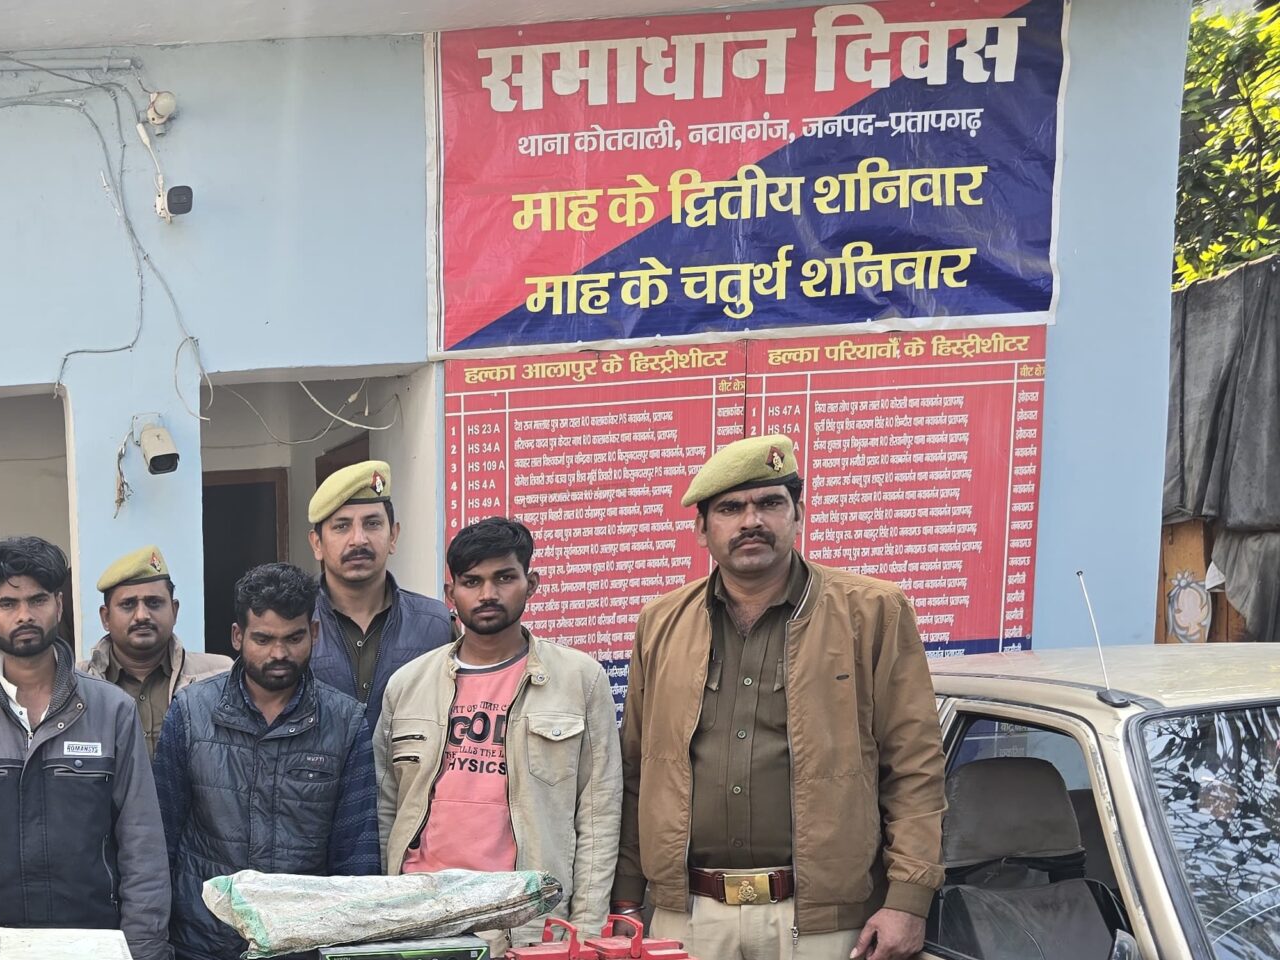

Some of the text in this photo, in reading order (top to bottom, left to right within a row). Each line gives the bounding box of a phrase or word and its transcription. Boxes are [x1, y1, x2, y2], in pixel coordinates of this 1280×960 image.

[478, 4, 1026, 112] समाधान दिवस
[517, 129, 570, 158] थाना
[574, 120, 683, 154] कोतवाली,
[688, 114, 795, 147] नवाबगंज,
[512, 156, 988, 235] माह के द्वितीय शनिवार
[525, 241, 977, 318] माह के चतुर्थ शनिवार
[768, 346, 820, 367] हल्का
[904, 337, 925, 358] के
[931, 333, 1030, 360] हिस्ट्रीशीटर
[464, 347, 728, 385] हल्का आलापुर के हिस्ट्रीशीटर
[752, 405, 801, 417] 1 HS 47 A
[451, 423, 500, 436] 1 HS 23 A
[750, 423, 800, 436] 2 HS 15 A
[450, 442, 500, 454] 2 HS 34 A
[451, 460, 505, 473] 3 HS 109 A
[451, 479, 496, 491] 4 HS 4 A
[451, 500, 457, 510] 5
[468, 498, 480, 509] HS
[494, 497, 501, 507] A
[451, 518, 457, 528] 6
[447, 758, 506, 775] HYSICS
